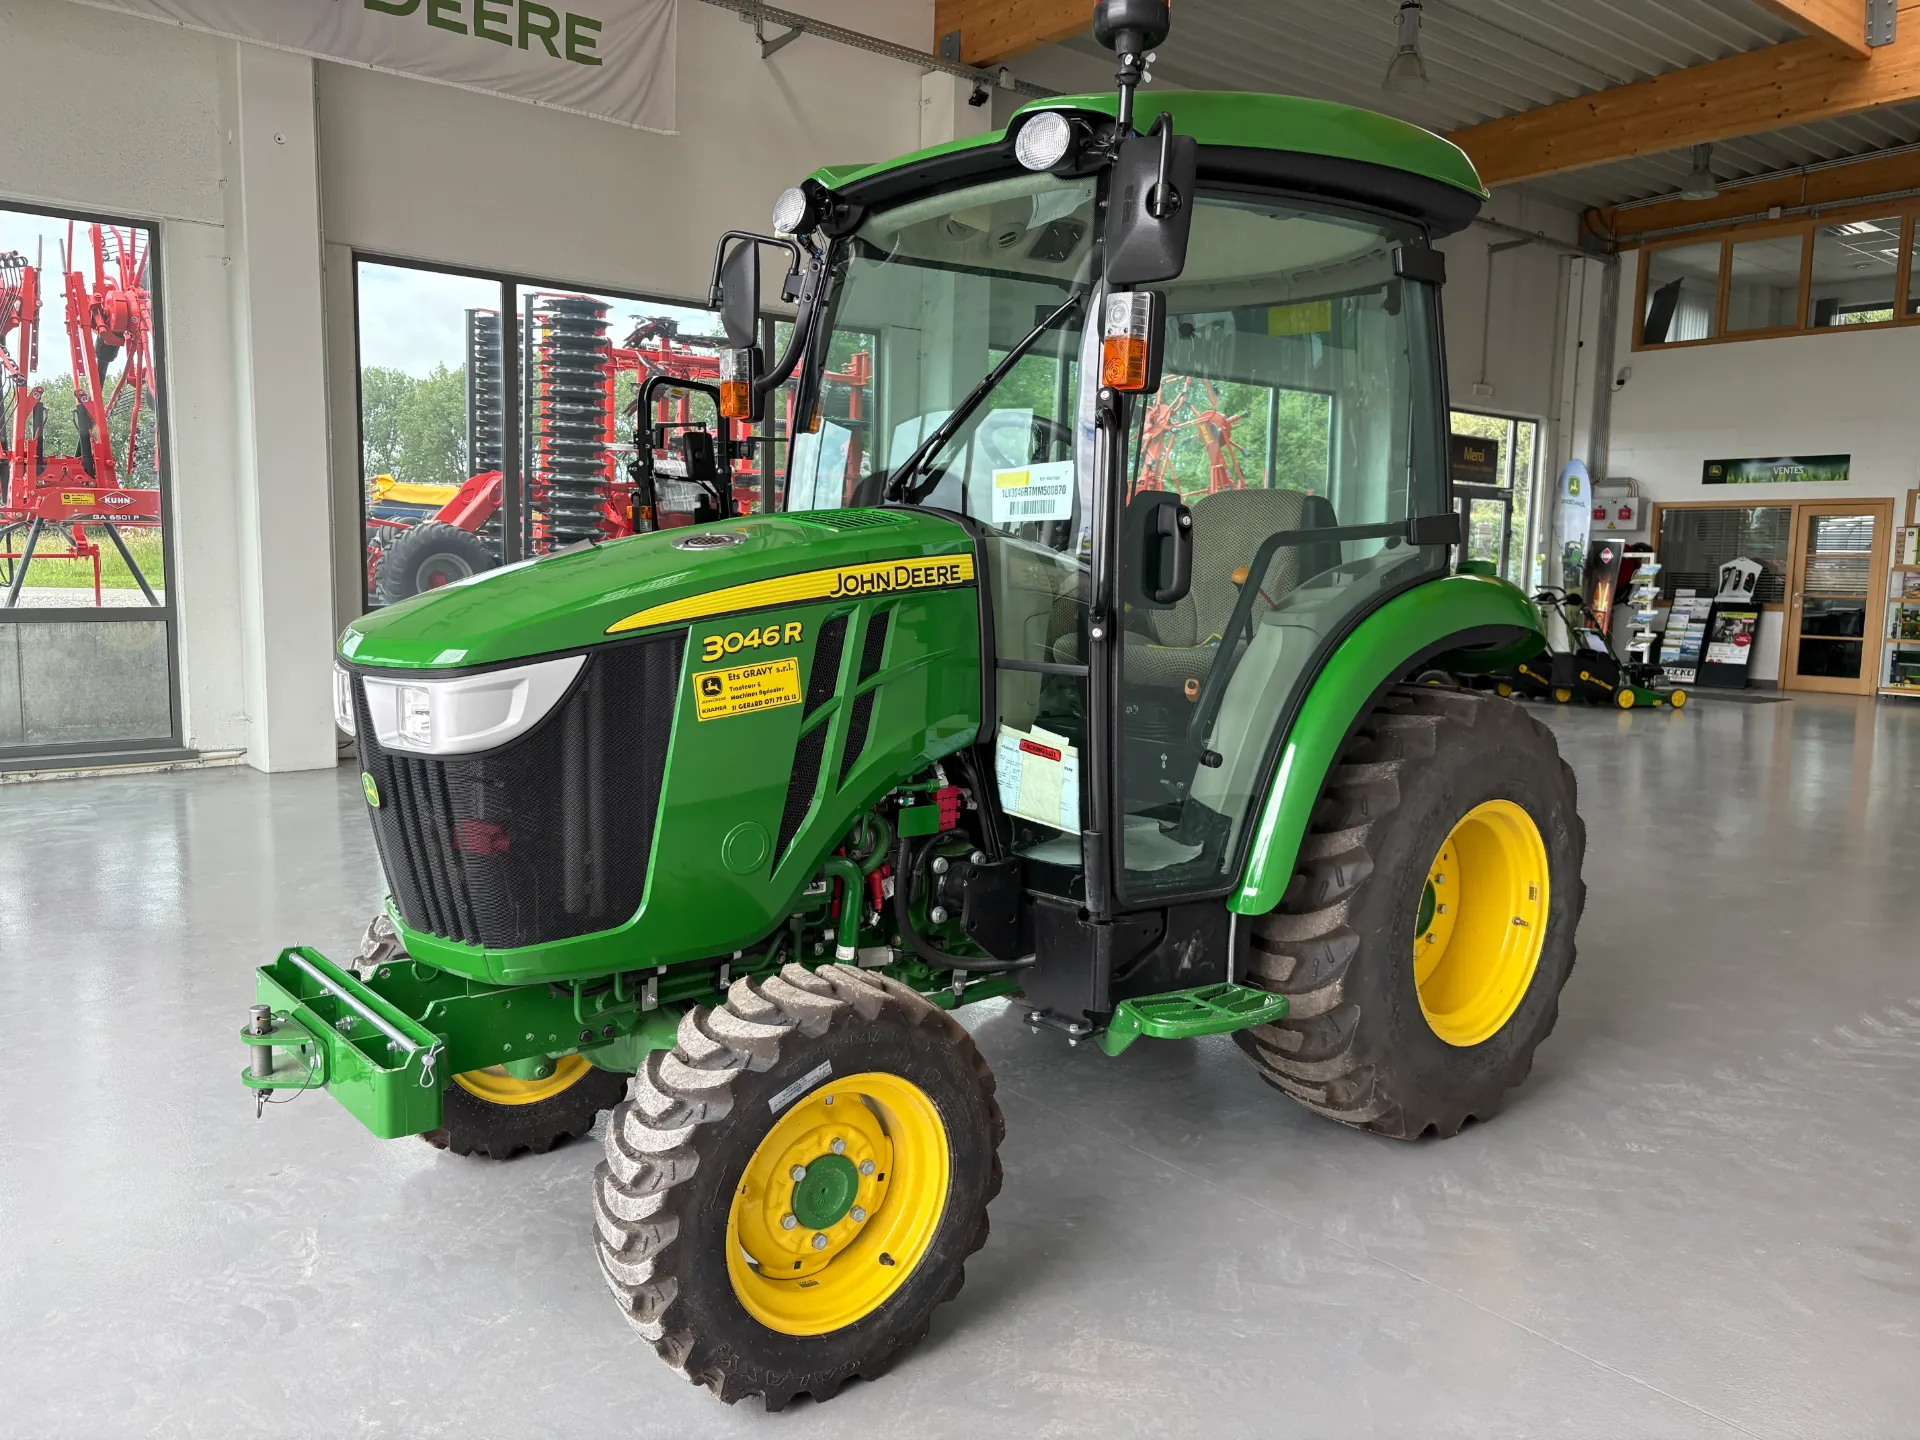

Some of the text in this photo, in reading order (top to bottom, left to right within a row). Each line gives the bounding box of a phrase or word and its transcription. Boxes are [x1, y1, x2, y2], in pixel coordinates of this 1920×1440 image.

[1464, 446, 1485, 463] Merci
[1773, 466, 1804, 475] VENTES
[104, 496, 131, 504] KUHN
[830, 565, 961, 596] JOHN DEERE
[702, 621, 803, 663] 3046R
[728, 663, 794, 681] Ets GRAVY s.r.l.
[702, 705, 727, 714] KRAMER
[738, 700, 763, 710] GERARD
[1023, 742, 1056, 758] PACKING LIST
